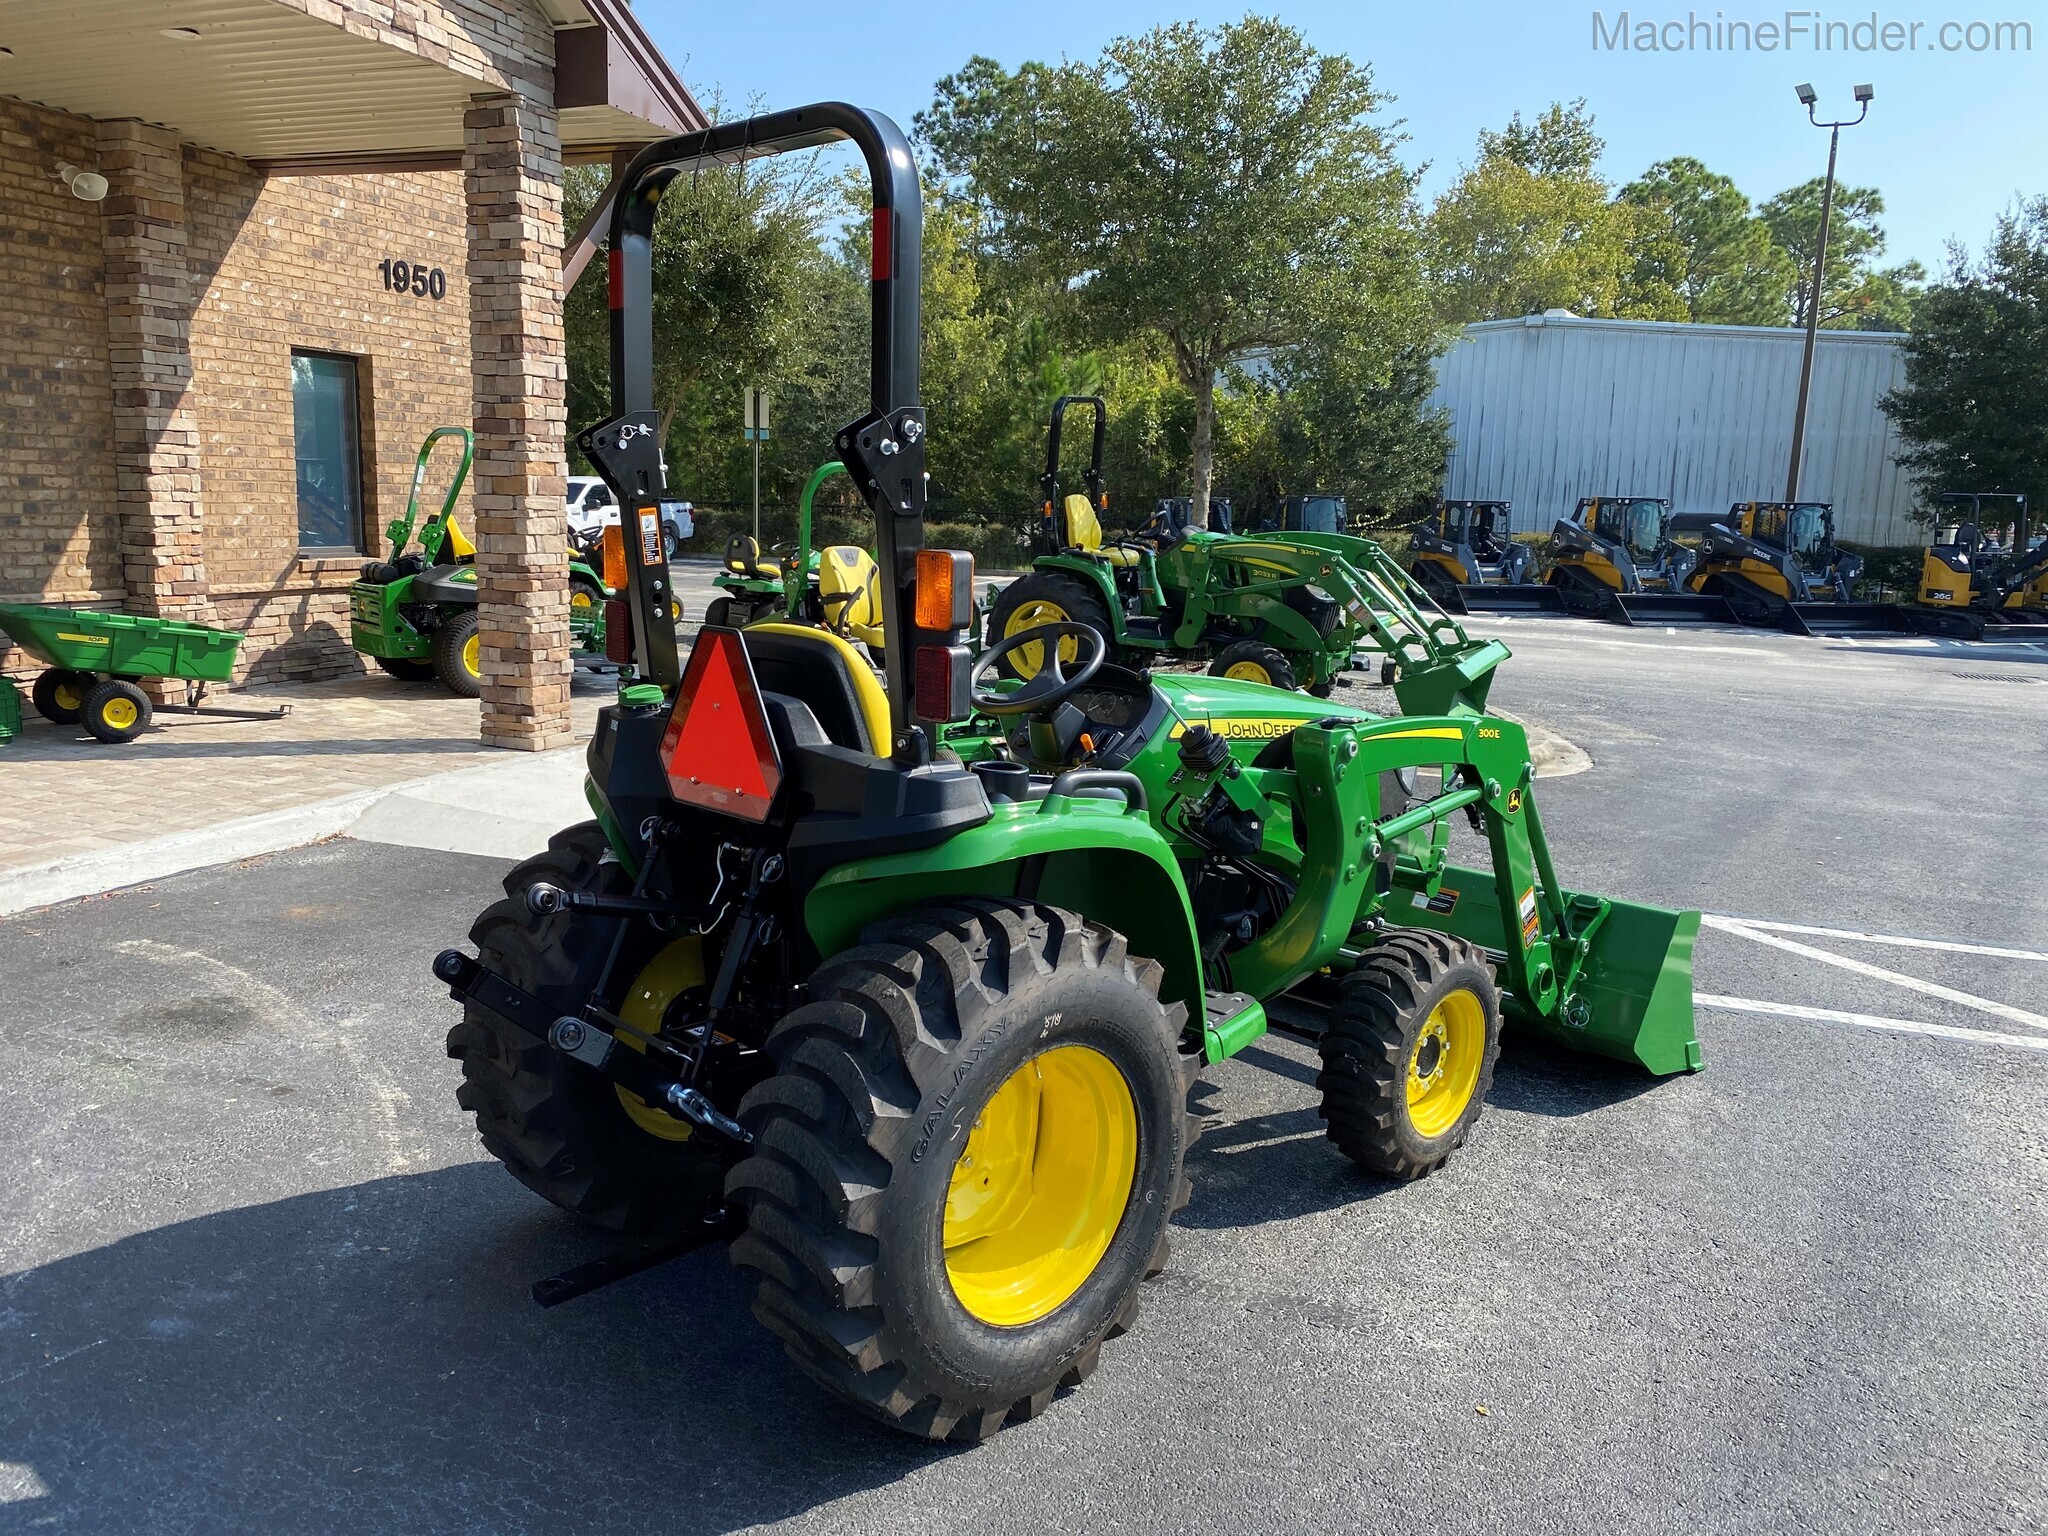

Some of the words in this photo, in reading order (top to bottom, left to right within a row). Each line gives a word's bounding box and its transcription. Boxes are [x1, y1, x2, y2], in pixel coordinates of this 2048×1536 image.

[378, 259, 446, 300] 1950
[1753, 548, 1771, 560] DEERE
[1933, 592, 1951, 600] 26G
[1224, 722, 1261, 737] JOHN
[1478, 729, 1500, 738] 300E
[911, 1016, 1007, 1163] GALAXY
